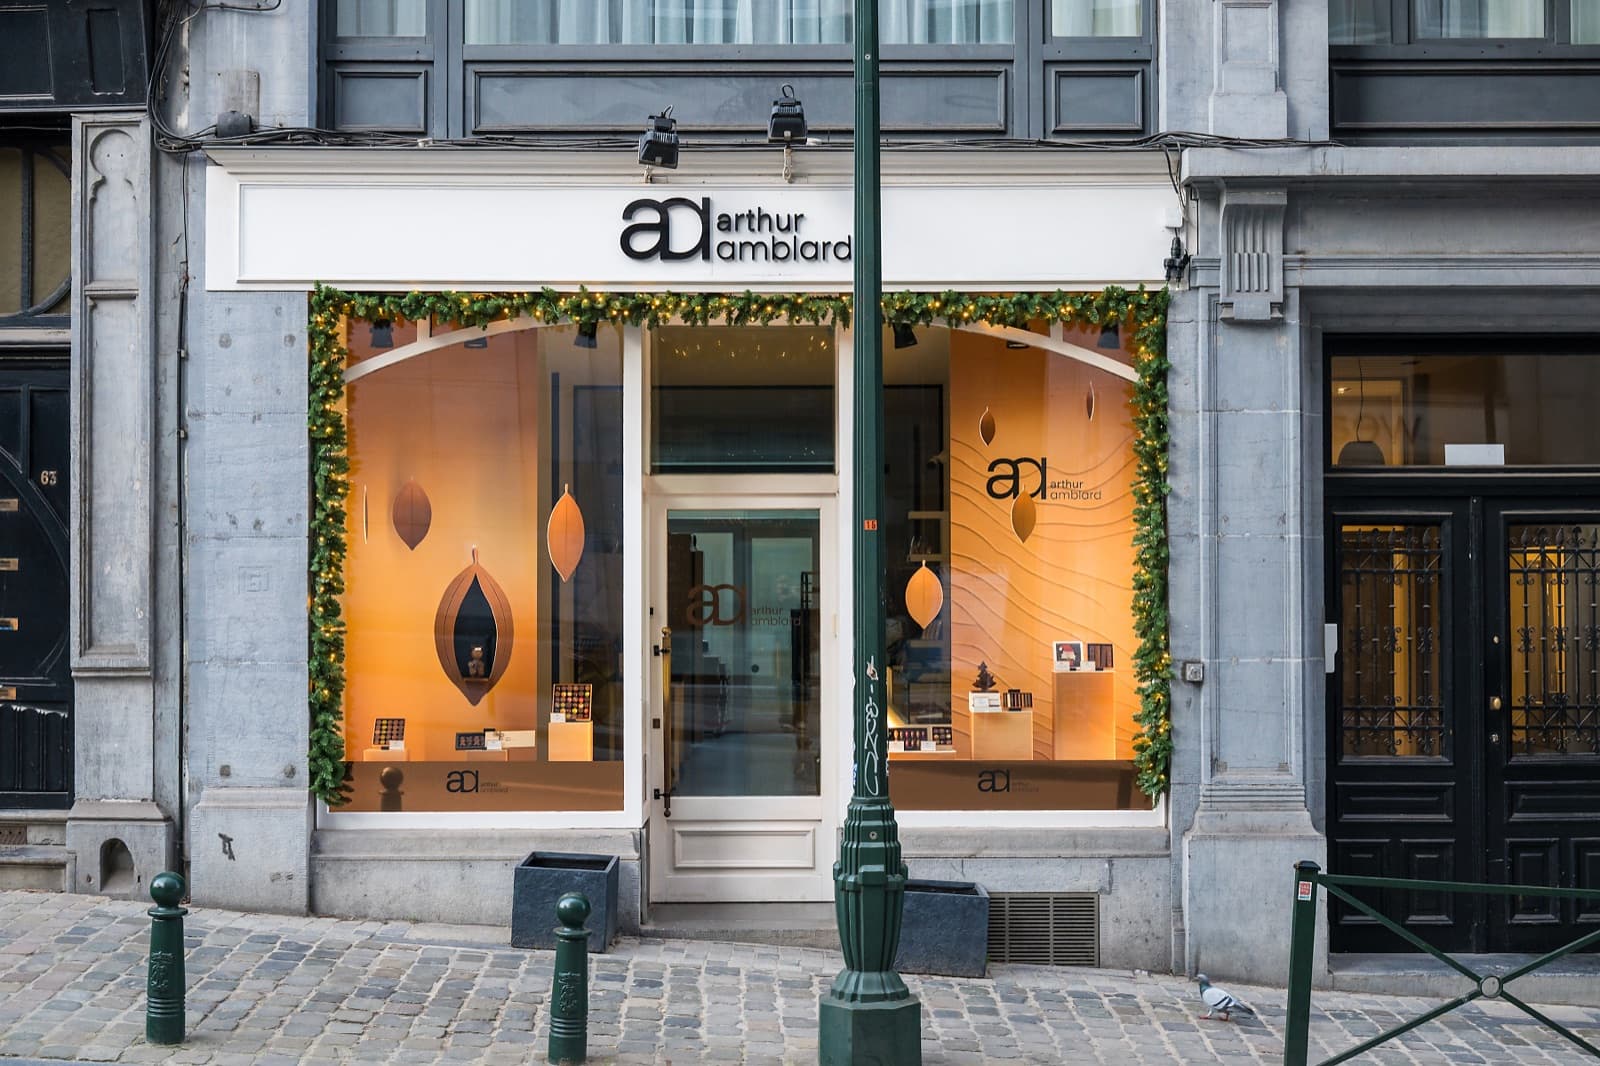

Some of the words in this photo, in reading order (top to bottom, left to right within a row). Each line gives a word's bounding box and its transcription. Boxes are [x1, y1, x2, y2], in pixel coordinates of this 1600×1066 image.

[716, 207, 804, 232] arthur
[716, 235, 852, 260] amblard
[41, 470, 56, 486] 63
[1050, 480, 1084, 489] arthur
[1050, 490, 1101, 500] amblard
